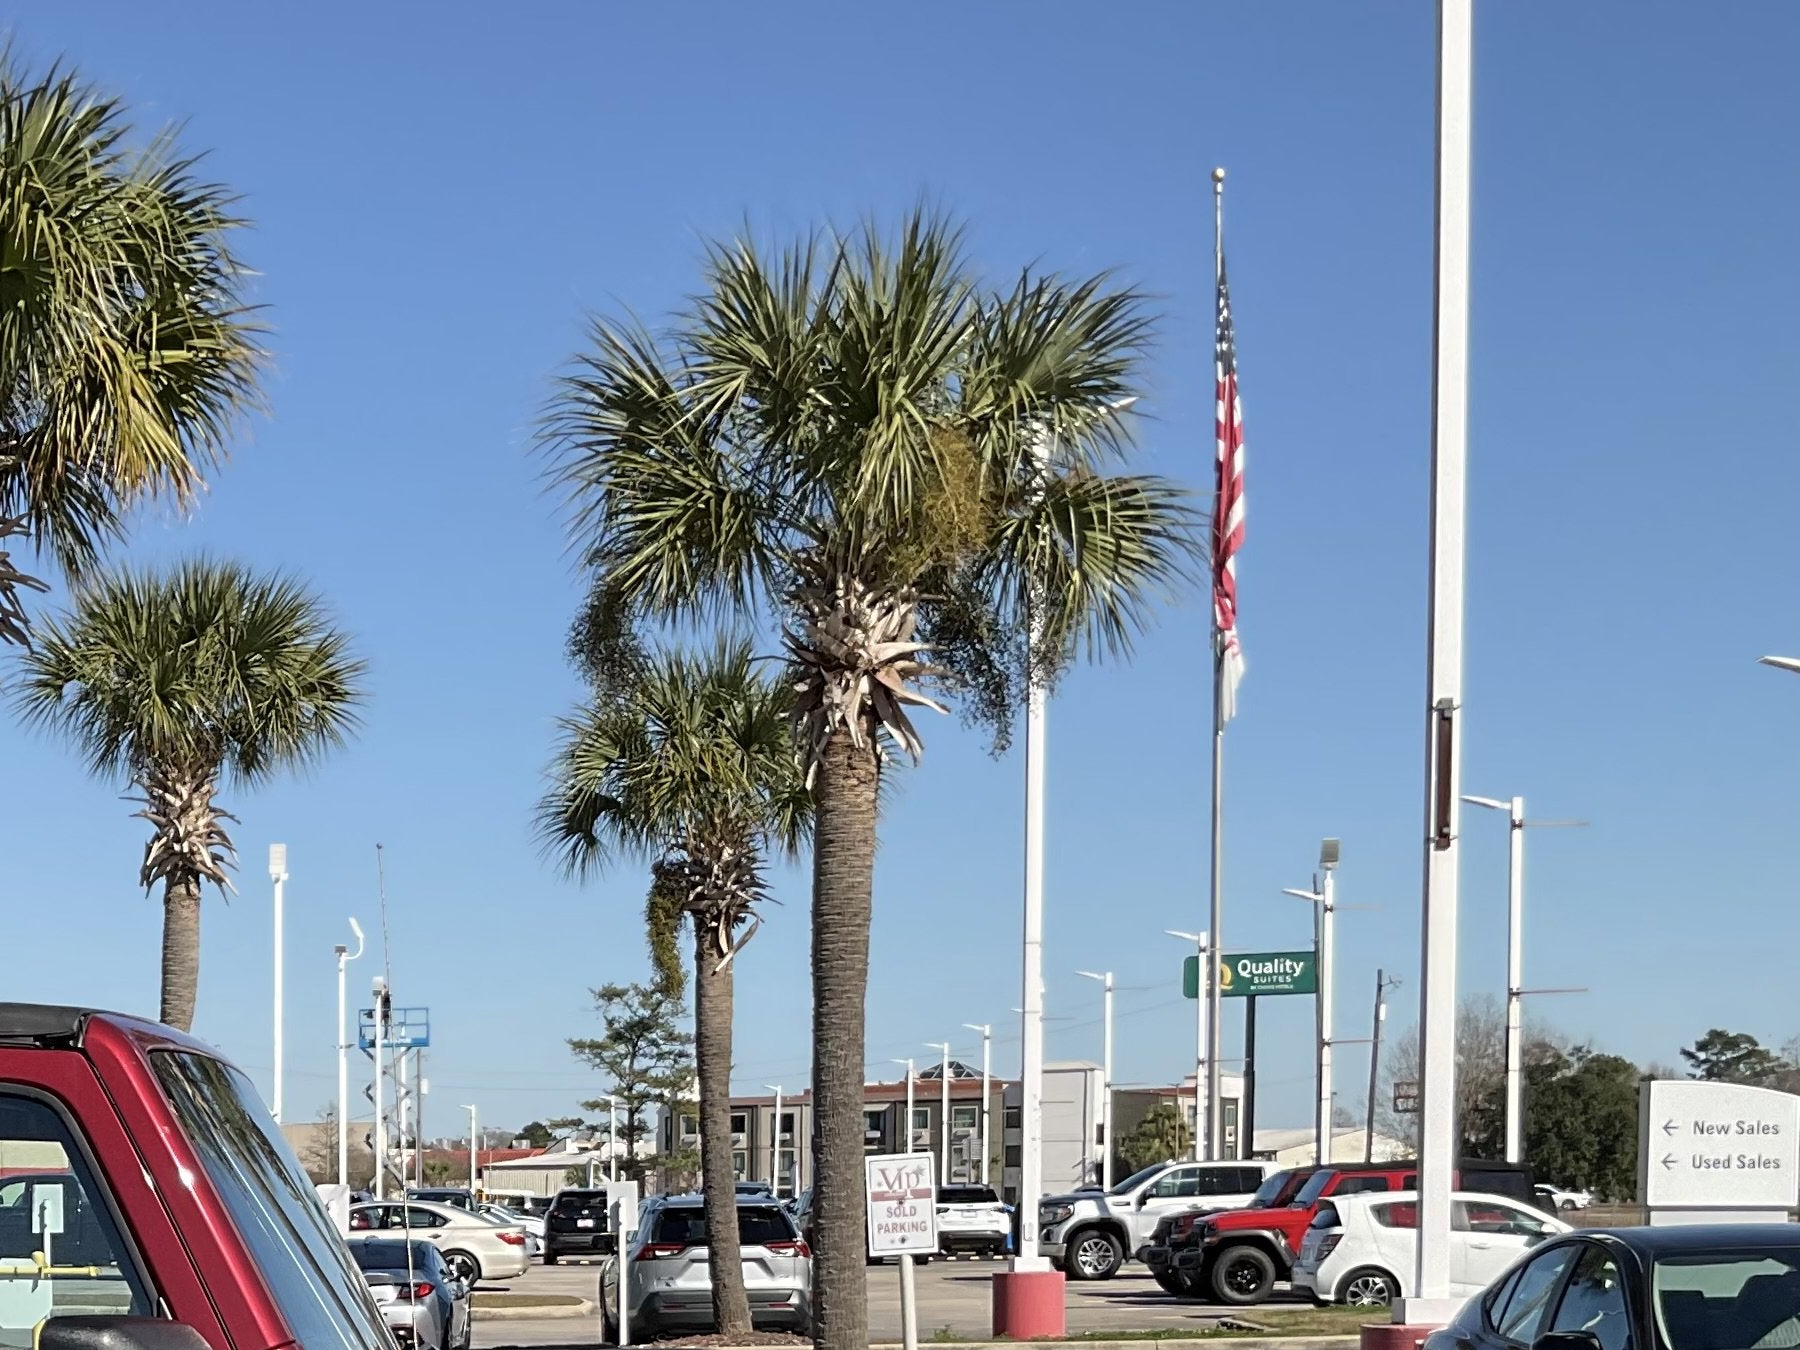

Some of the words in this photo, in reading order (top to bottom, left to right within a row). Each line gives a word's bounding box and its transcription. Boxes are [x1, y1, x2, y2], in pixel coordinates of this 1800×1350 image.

[1237, 957, 1304, 978] Quality
[1253, 975, 1292, 984] SUITES
[1693, 1119, 1731, 1135] New
[1735, 1119, 1780, 1135] Sales
[1692, 1153, 1731, 1169] Used
[1736, 1153, 1781, 1169] Sales
[886, 1205, 917, 1219] SOLD
[877, 1220, 928, 1234] PARKING
